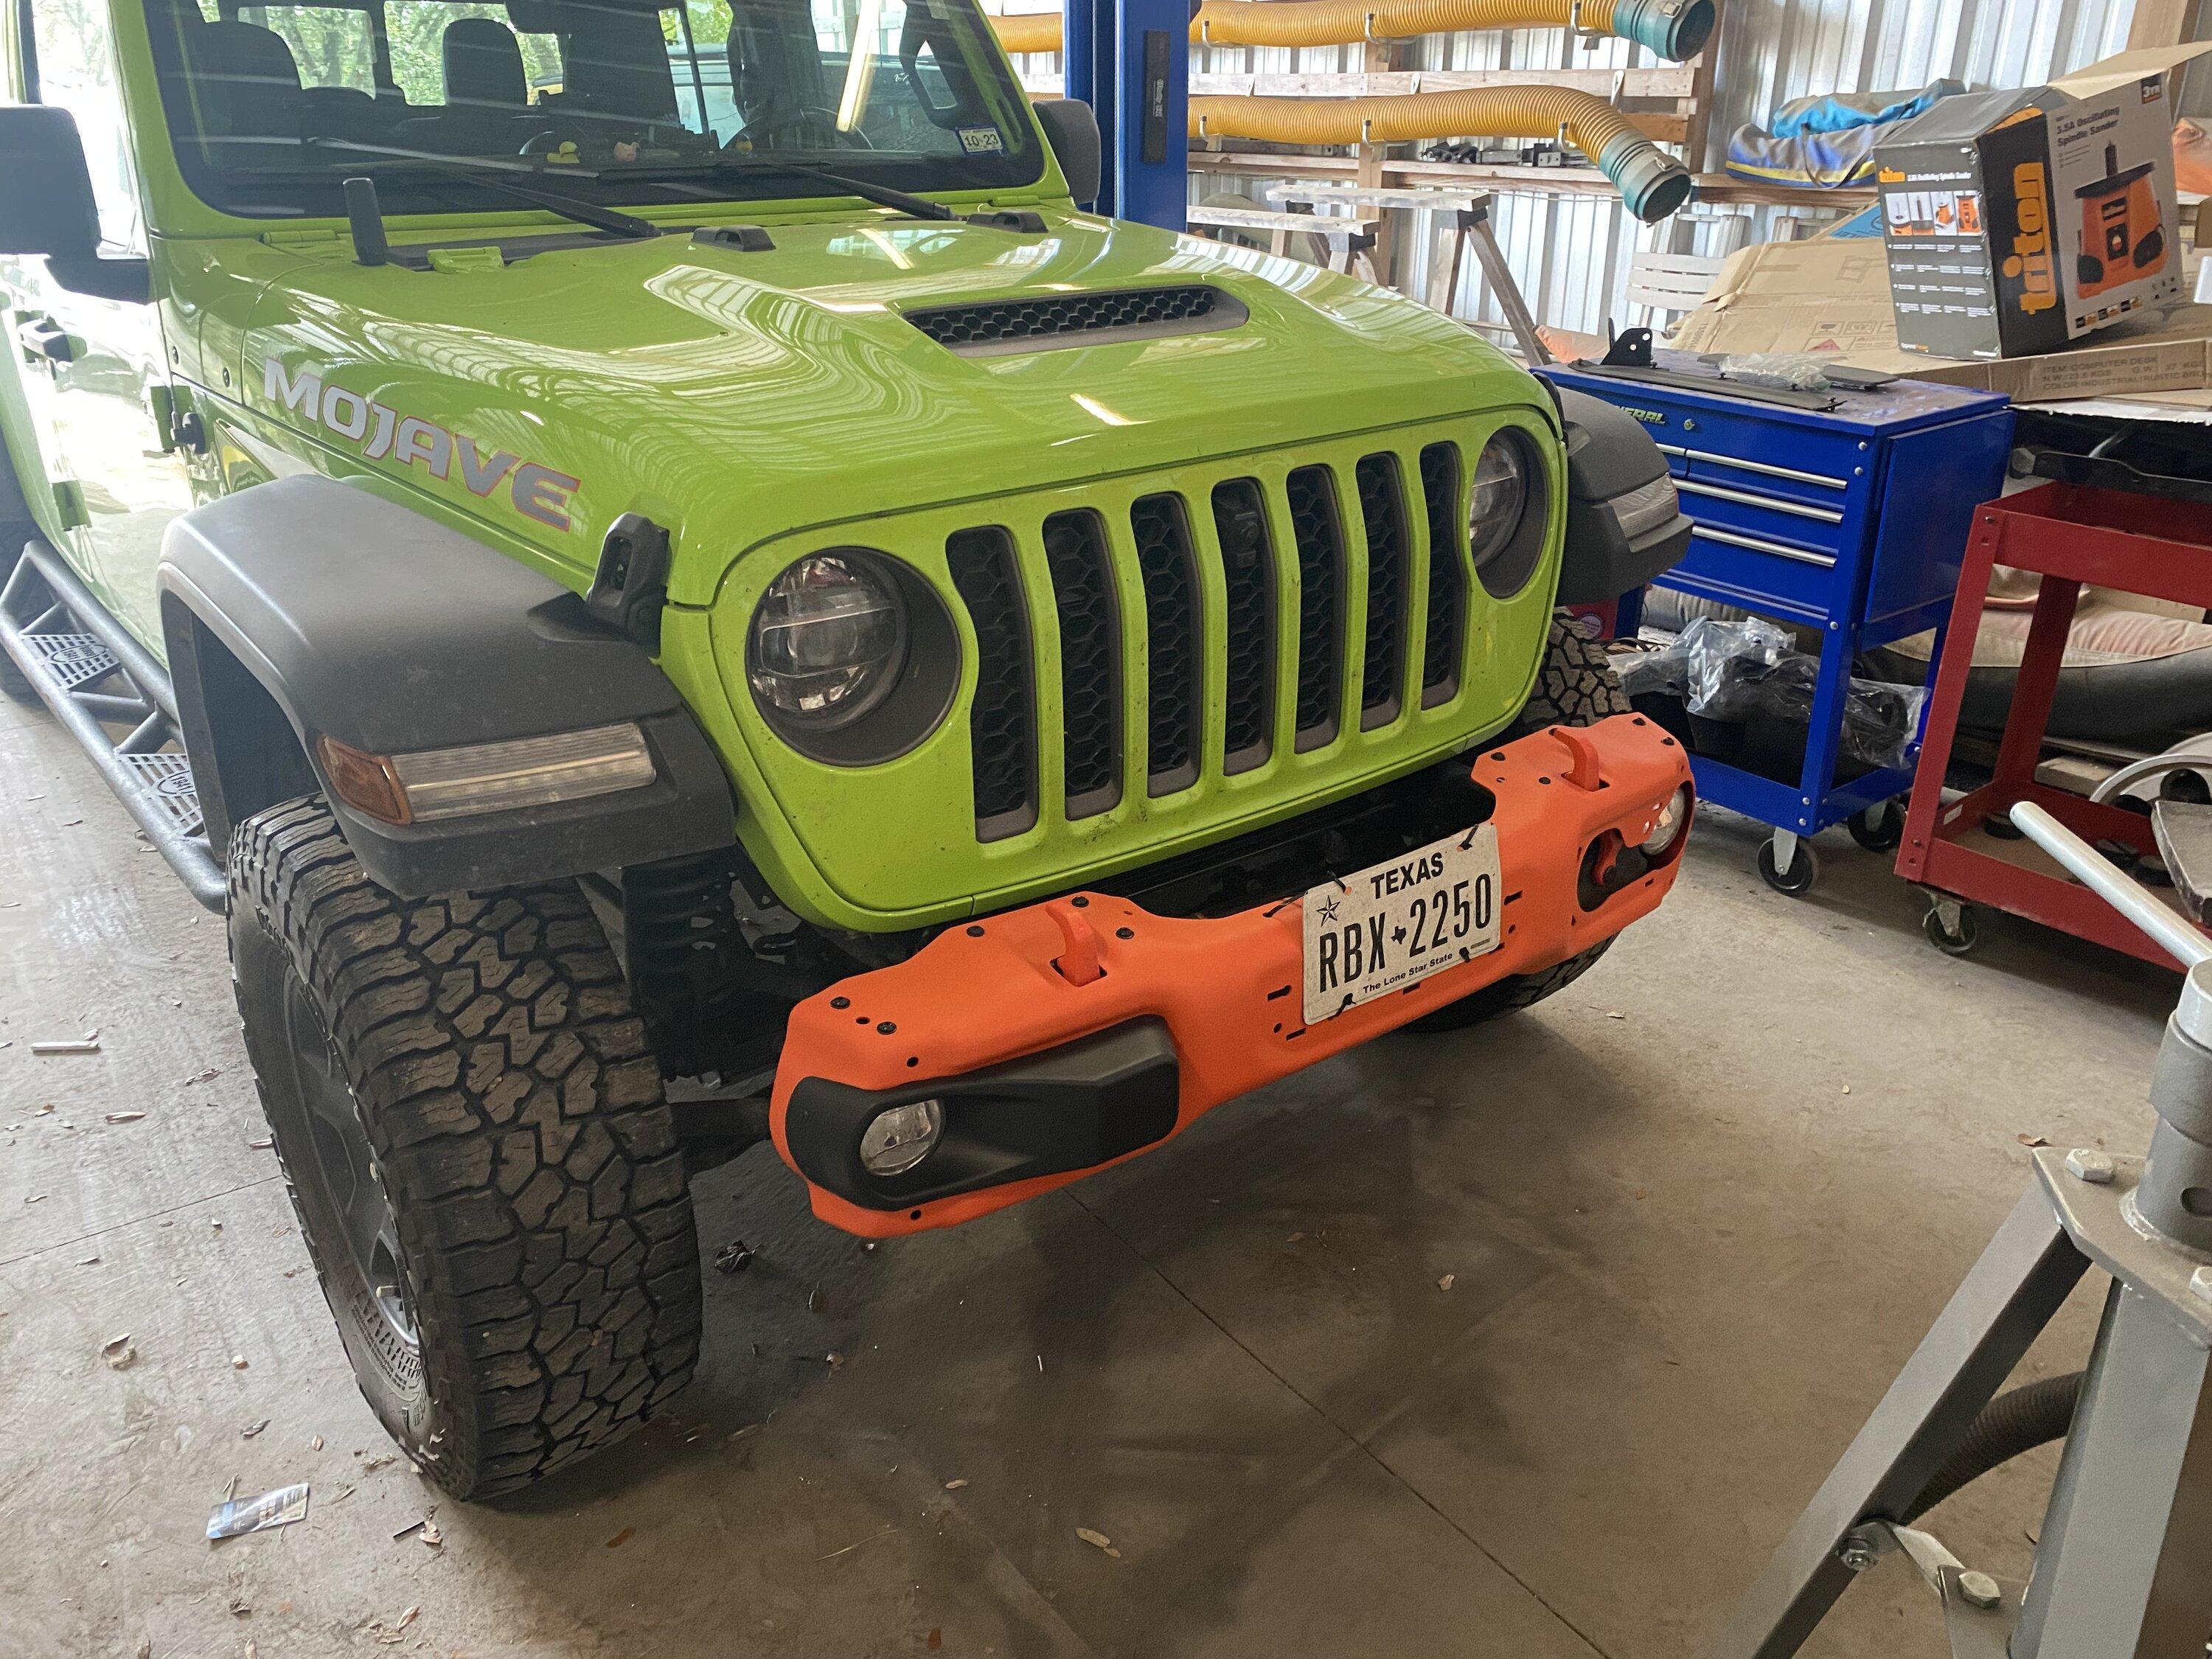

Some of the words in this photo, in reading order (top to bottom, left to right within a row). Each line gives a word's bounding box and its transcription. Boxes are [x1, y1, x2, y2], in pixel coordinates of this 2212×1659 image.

[2057, 131, 2088, 147] Spindle
[2090, 119, 2118, 136] Sander
[2076, 106, 2120, 127] Oscillating
[964, 136, 979, 147] 10
[983, 133, 999, 145] 23
[2070, 358, 2128, 372] COMPUTER
[2129, 356, 2157, 366] DESK
[263, 358, 581, 532] MOJAVE
[1370, 852, 1444, 900] TEXAS
[1319, 911, 1386, 993] RBX
[1409, 873, 1492, 958] 2250
[1363, 983, 1381, 994] The
[1384, 972, 1406, 986] Lone
[1408, 962, 1427, 976] Star
[1429, 953, 1453, 967] State
